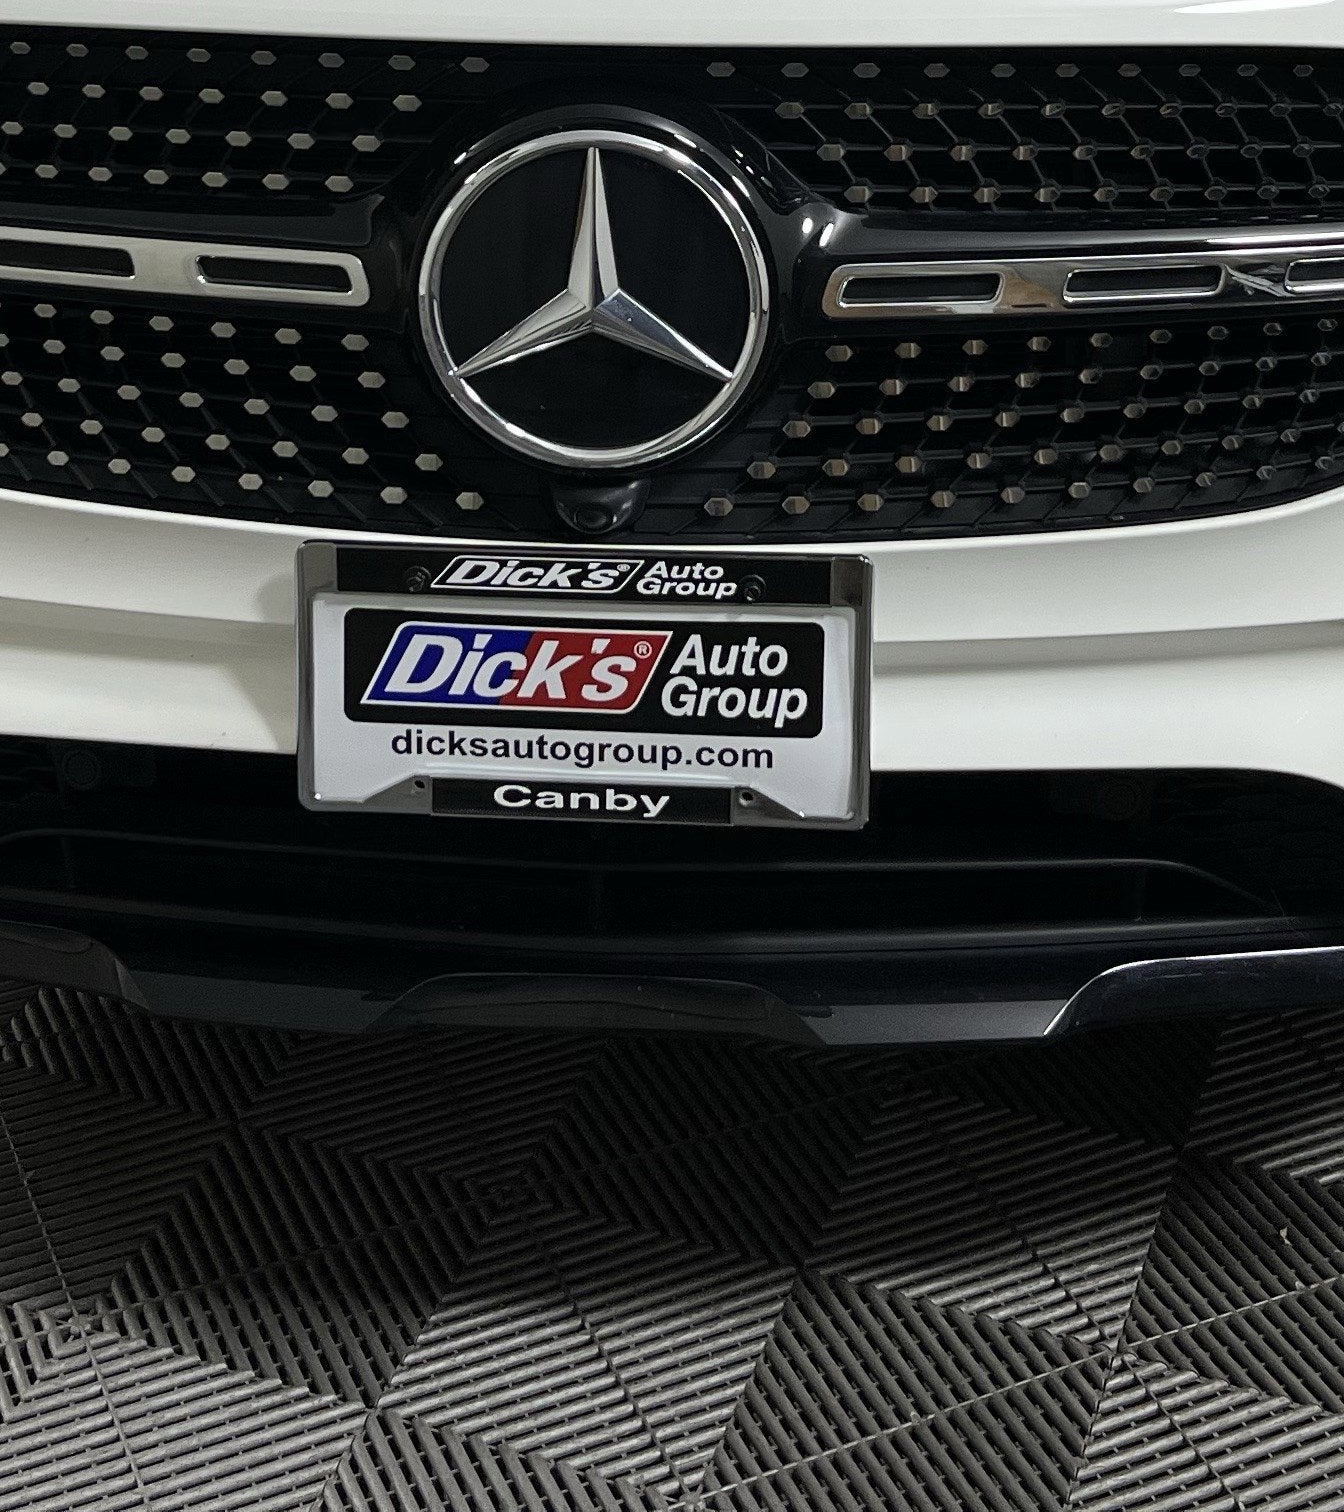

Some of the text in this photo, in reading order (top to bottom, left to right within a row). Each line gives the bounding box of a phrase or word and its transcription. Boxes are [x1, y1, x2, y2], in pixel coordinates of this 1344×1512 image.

[445, 559, 621, 590] Dick's
[636, 577, 738, 601] Group
[644, 560, 725, 581] Auto
[384, 633, 638, 703] Dick's
[670, 633, 789, 678] Auto
[660, 675, 808, 729] Group
[390, 728, 775, 771] dicksautogroup.com
[492, 784, 671, 819] Canby
